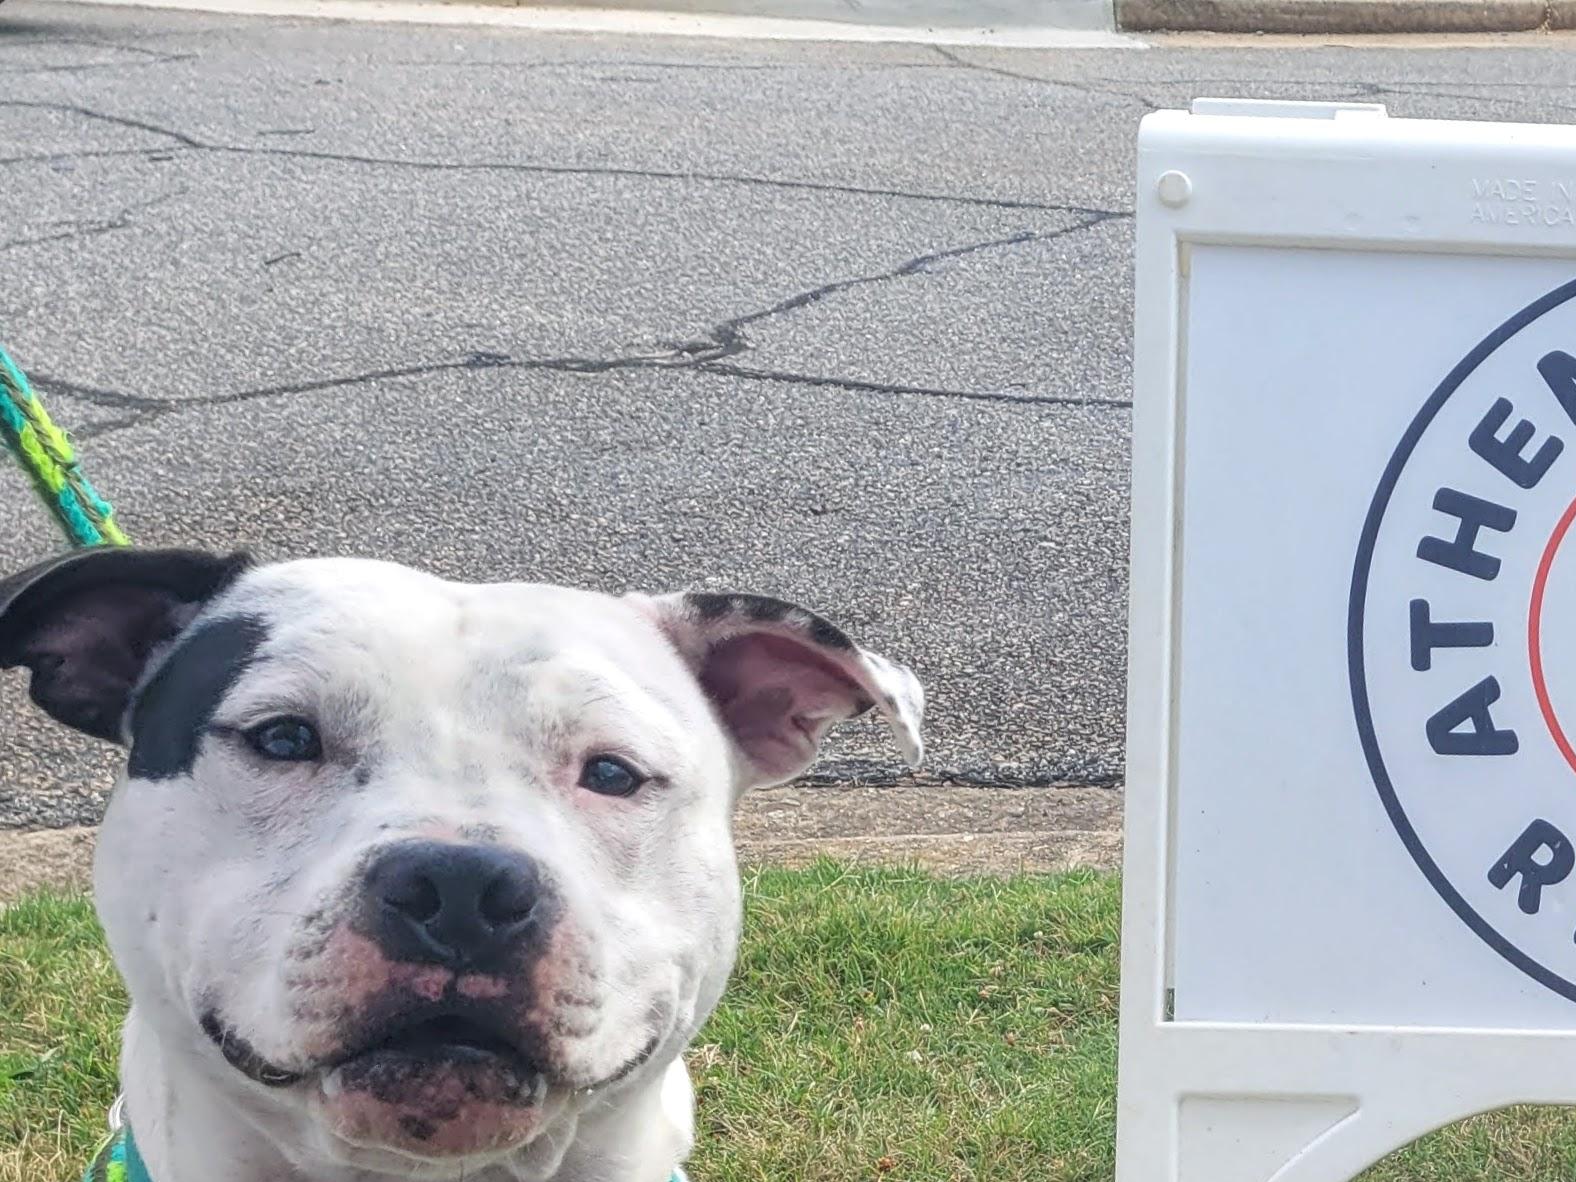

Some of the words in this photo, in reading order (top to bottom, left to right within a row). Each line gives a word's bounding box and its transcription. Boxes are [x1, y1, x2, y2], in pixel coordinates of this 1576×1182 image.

[1471, 177, 1537, 202] MADE
[1551, 180, 1575, 203] IN
[1471, 202, 1576, 227] AMERICA
